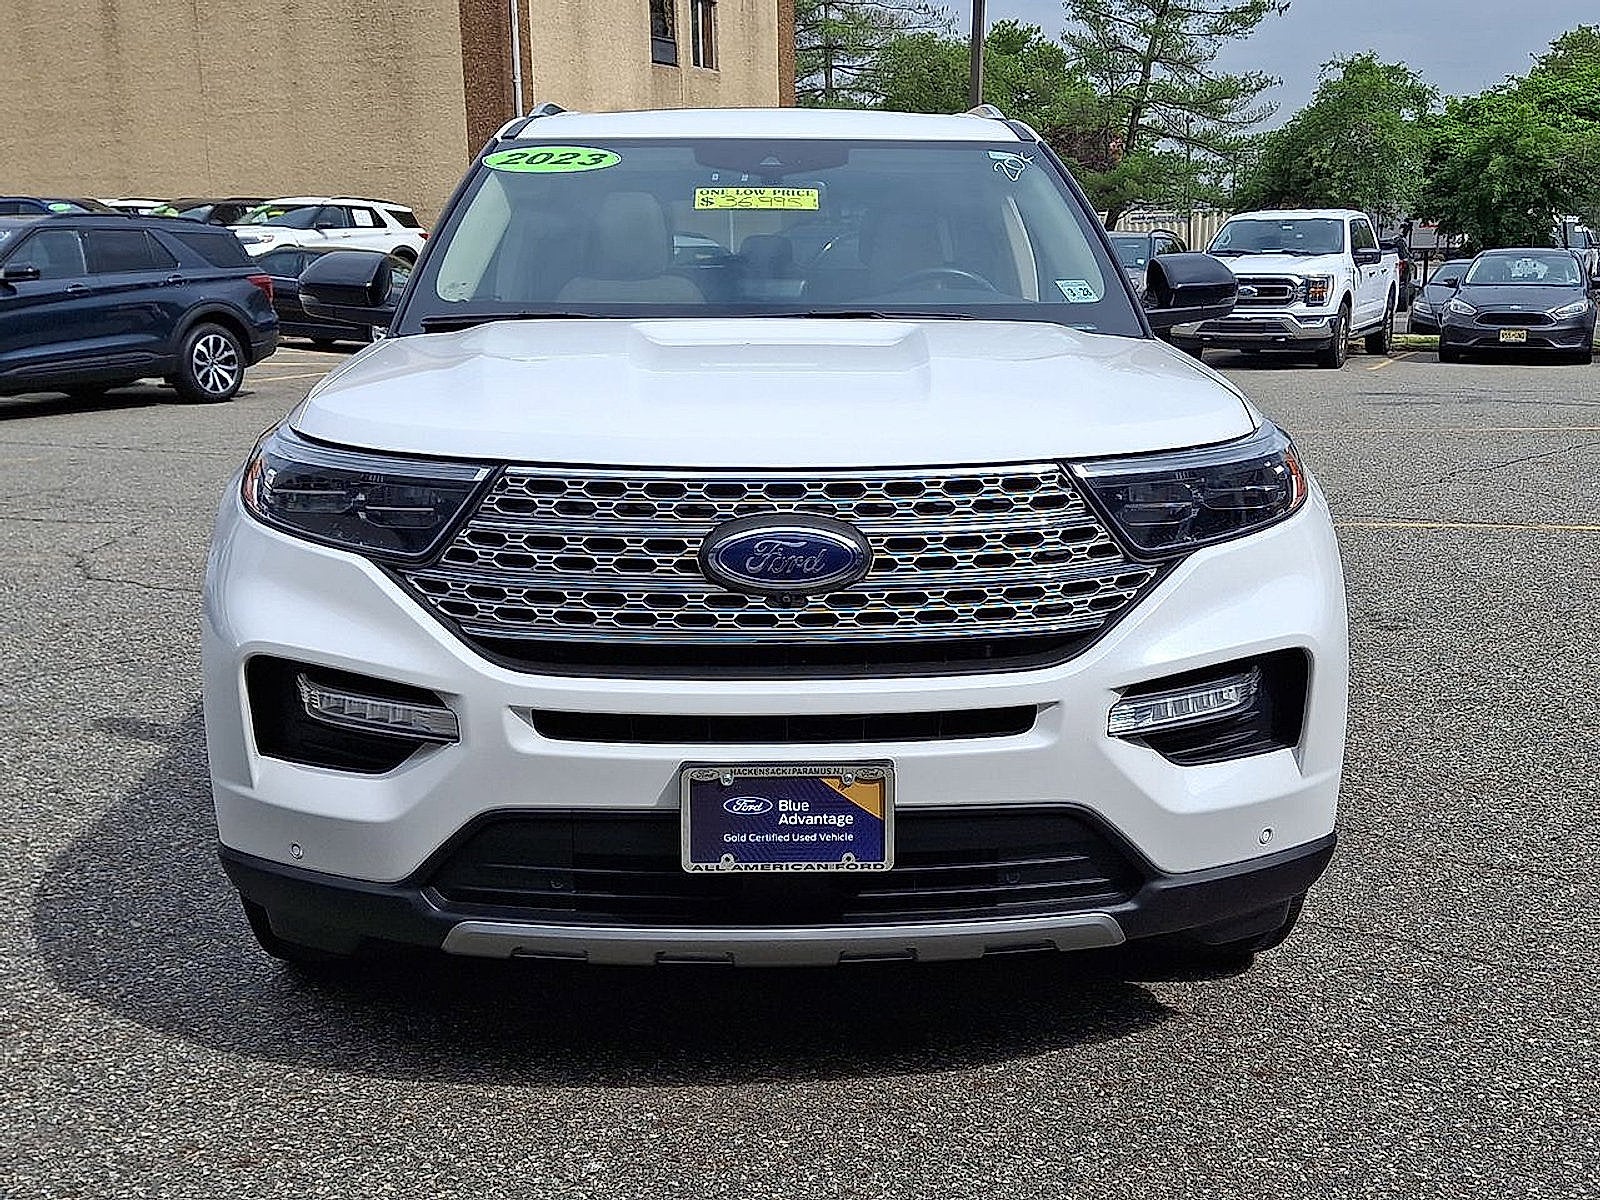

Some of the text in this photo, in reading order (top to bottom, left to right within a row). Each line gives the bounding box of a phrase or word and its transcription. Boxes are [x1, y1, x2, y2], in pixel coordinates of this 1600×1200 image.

[496, 152, 608, 166] 2023
[745, 539, 828, 574] Ford
[732, 798, 763, 812] Ford
[778, 799, 810, 812] Blue
[778, 812, 854, 828] Advantage
[723, 832, 854, 842] Gold Certified Used Vehicle
[691, 863, 885, 872] ALL AMERICAN FORD
